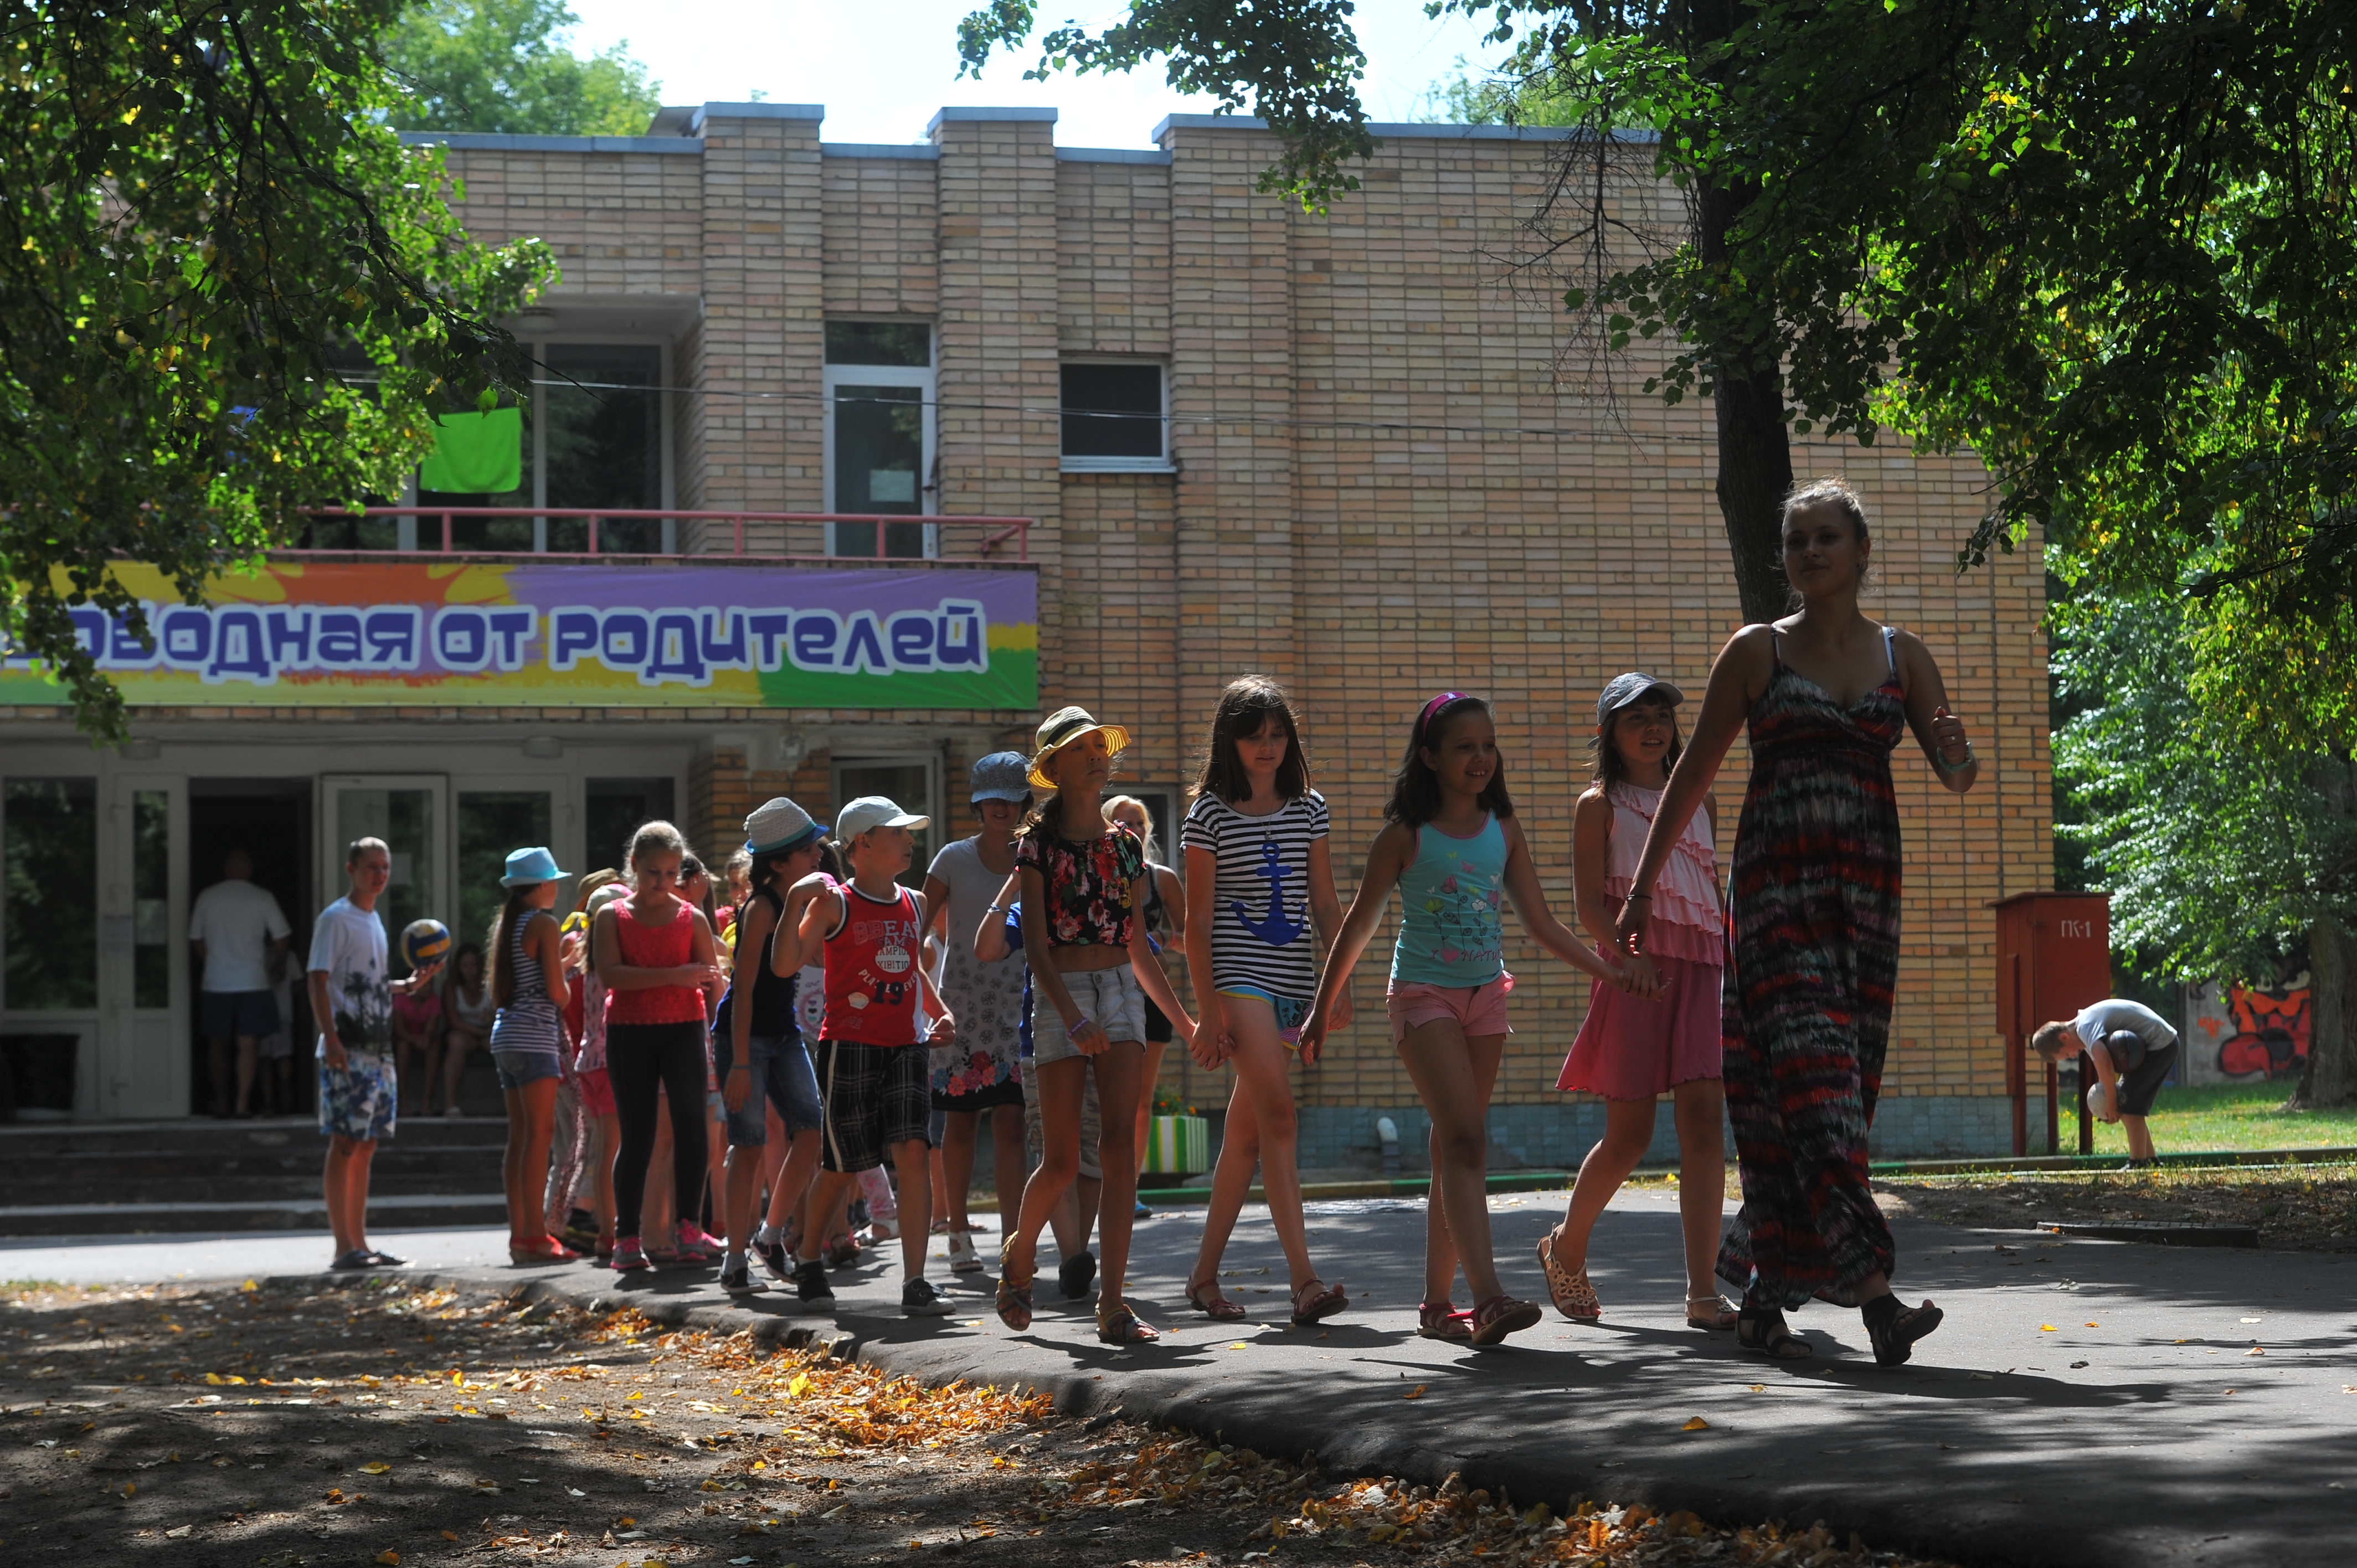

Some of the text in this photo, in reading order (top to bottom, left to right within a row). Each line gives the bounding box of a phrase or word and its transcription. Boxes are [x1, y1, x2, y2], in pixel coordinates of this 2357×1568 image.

[2061, 920, 2091, 938] ПК-1
[877, 946, 909, 956] AMPIO
[1430, 949, 1439, 960] I
[858, 968, 898, 993] PLAE
[873, 981, 904, 1006] 19
